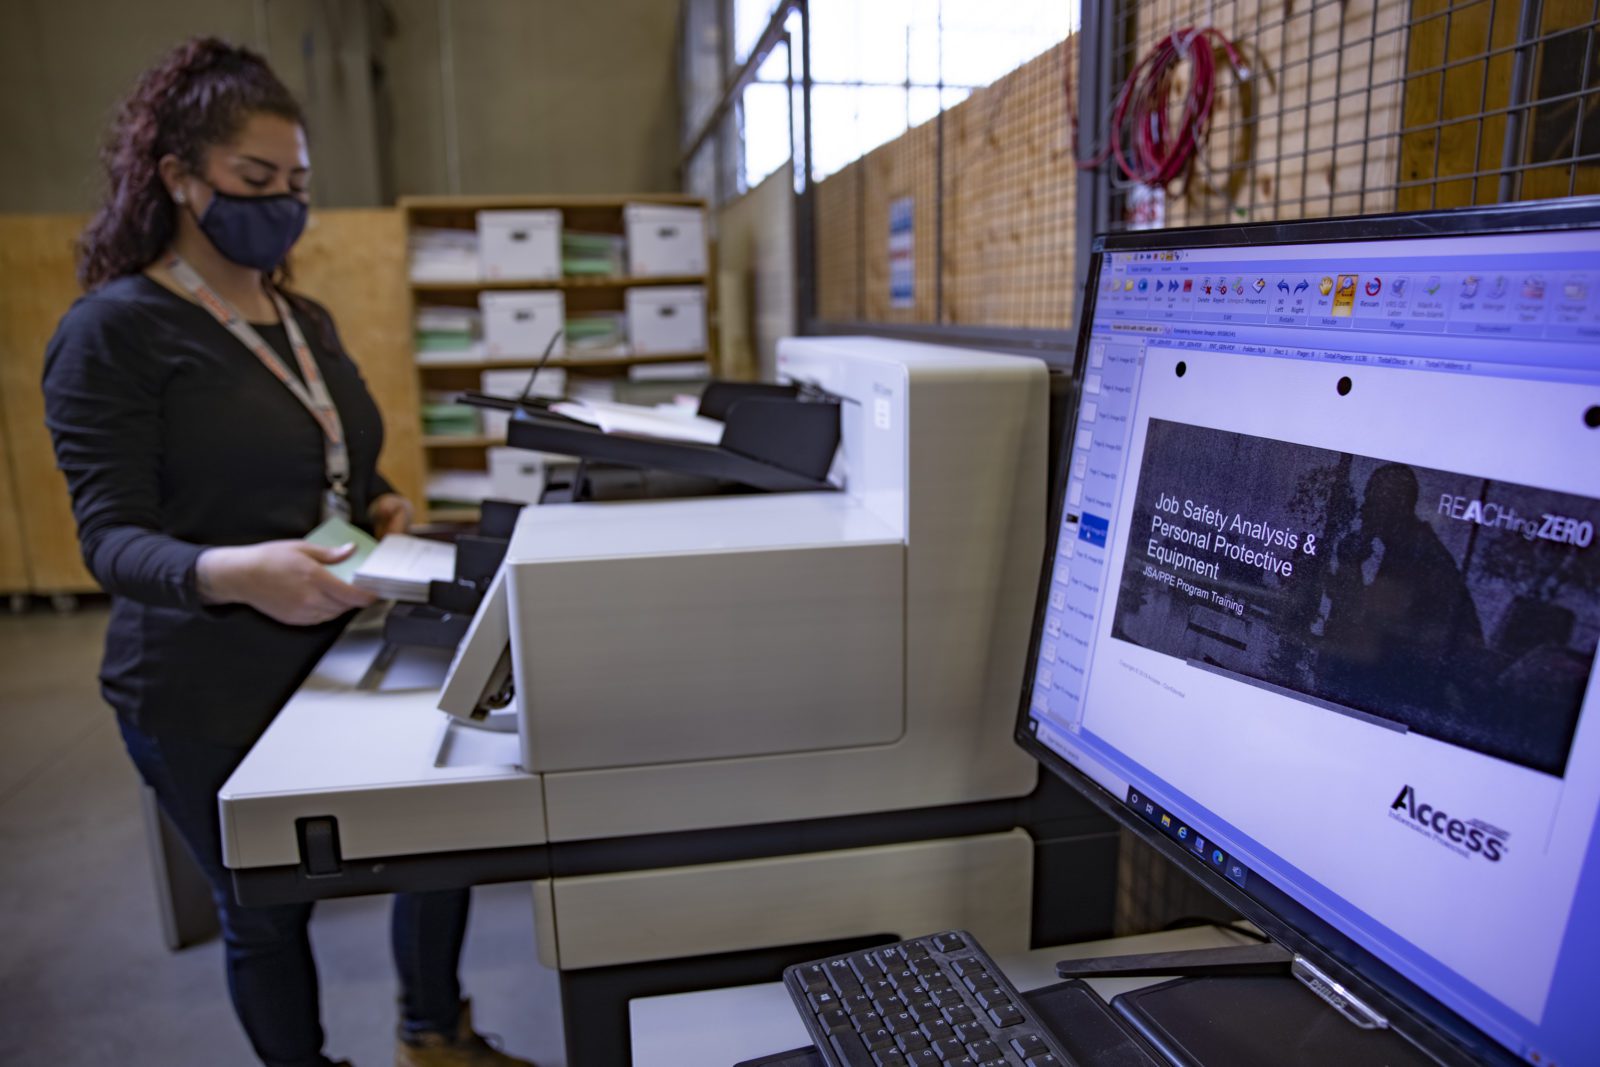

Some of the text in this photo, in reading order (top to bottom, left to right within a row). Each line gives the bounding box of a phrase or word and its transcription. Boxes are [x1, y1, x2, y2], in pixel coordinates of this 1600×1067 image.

[1390, 321, 1405, 329] Page
[1152, 515, 1293, 578] Personal Protective
[1155, 492, 1316, 556] Job Safety Analysis &
[1147, 538, 1220, 580] Equipment
[1142, 566, 1244, 616] JSA/PPE Program Training
[1390, 784, 1502, 863] Access
[1309, 978, 1348, 1008] PHILIPS
